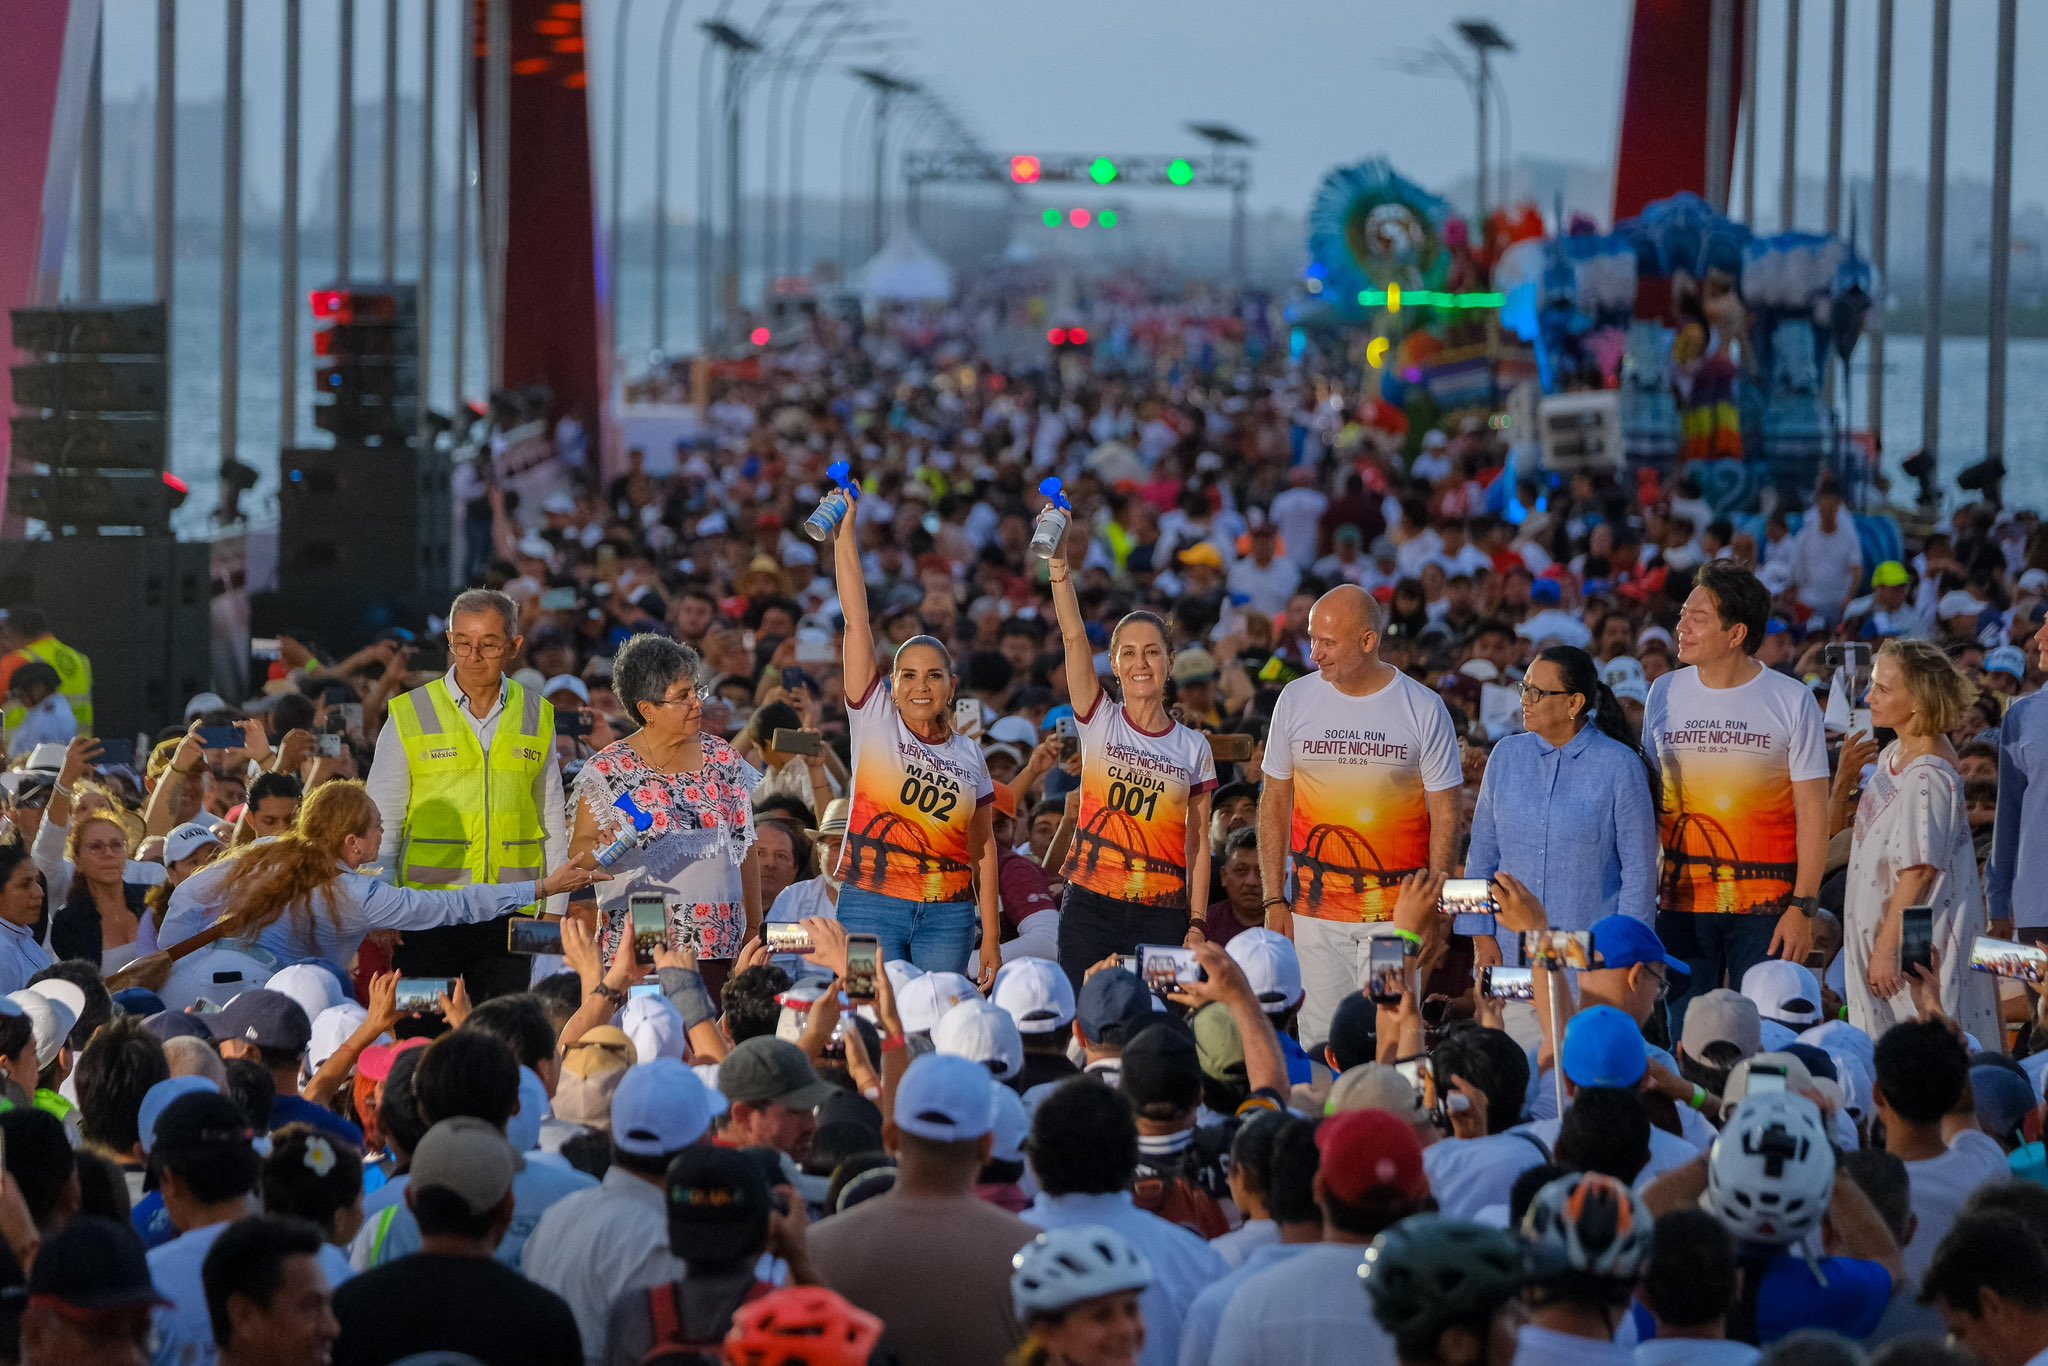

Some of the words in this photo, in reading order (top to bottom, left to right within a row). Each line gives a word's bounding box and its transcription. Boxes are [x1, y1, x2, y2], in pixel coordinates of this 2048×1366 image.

[1684, 720, 1721, 729] SOCIAL
[1725, 720, 1748, 730] RUN
[1324, 729, 1361, 740] SOCIAL
[1364, 731, 1386, 742] RUN
[1663, 730, 1707, 744] PUENTE
[1708, 731, 1771, 749] NICHUPTÉ
[430, 751, 457, 760] México
[523, 747, 542, 763] SICT
[1302, 740, 1347, 755] PUENTE
[1348, 741, 1408, 760] NICHUPTÉ
[1338, 757, 1368, 765] 02.05.26
[906, 764, 960, 793] MARA
[1107, 766, 1165, 793] CLAUDIA
[900, 778, 957, 823] 002
[1108, 782, 1158, 822] 001
